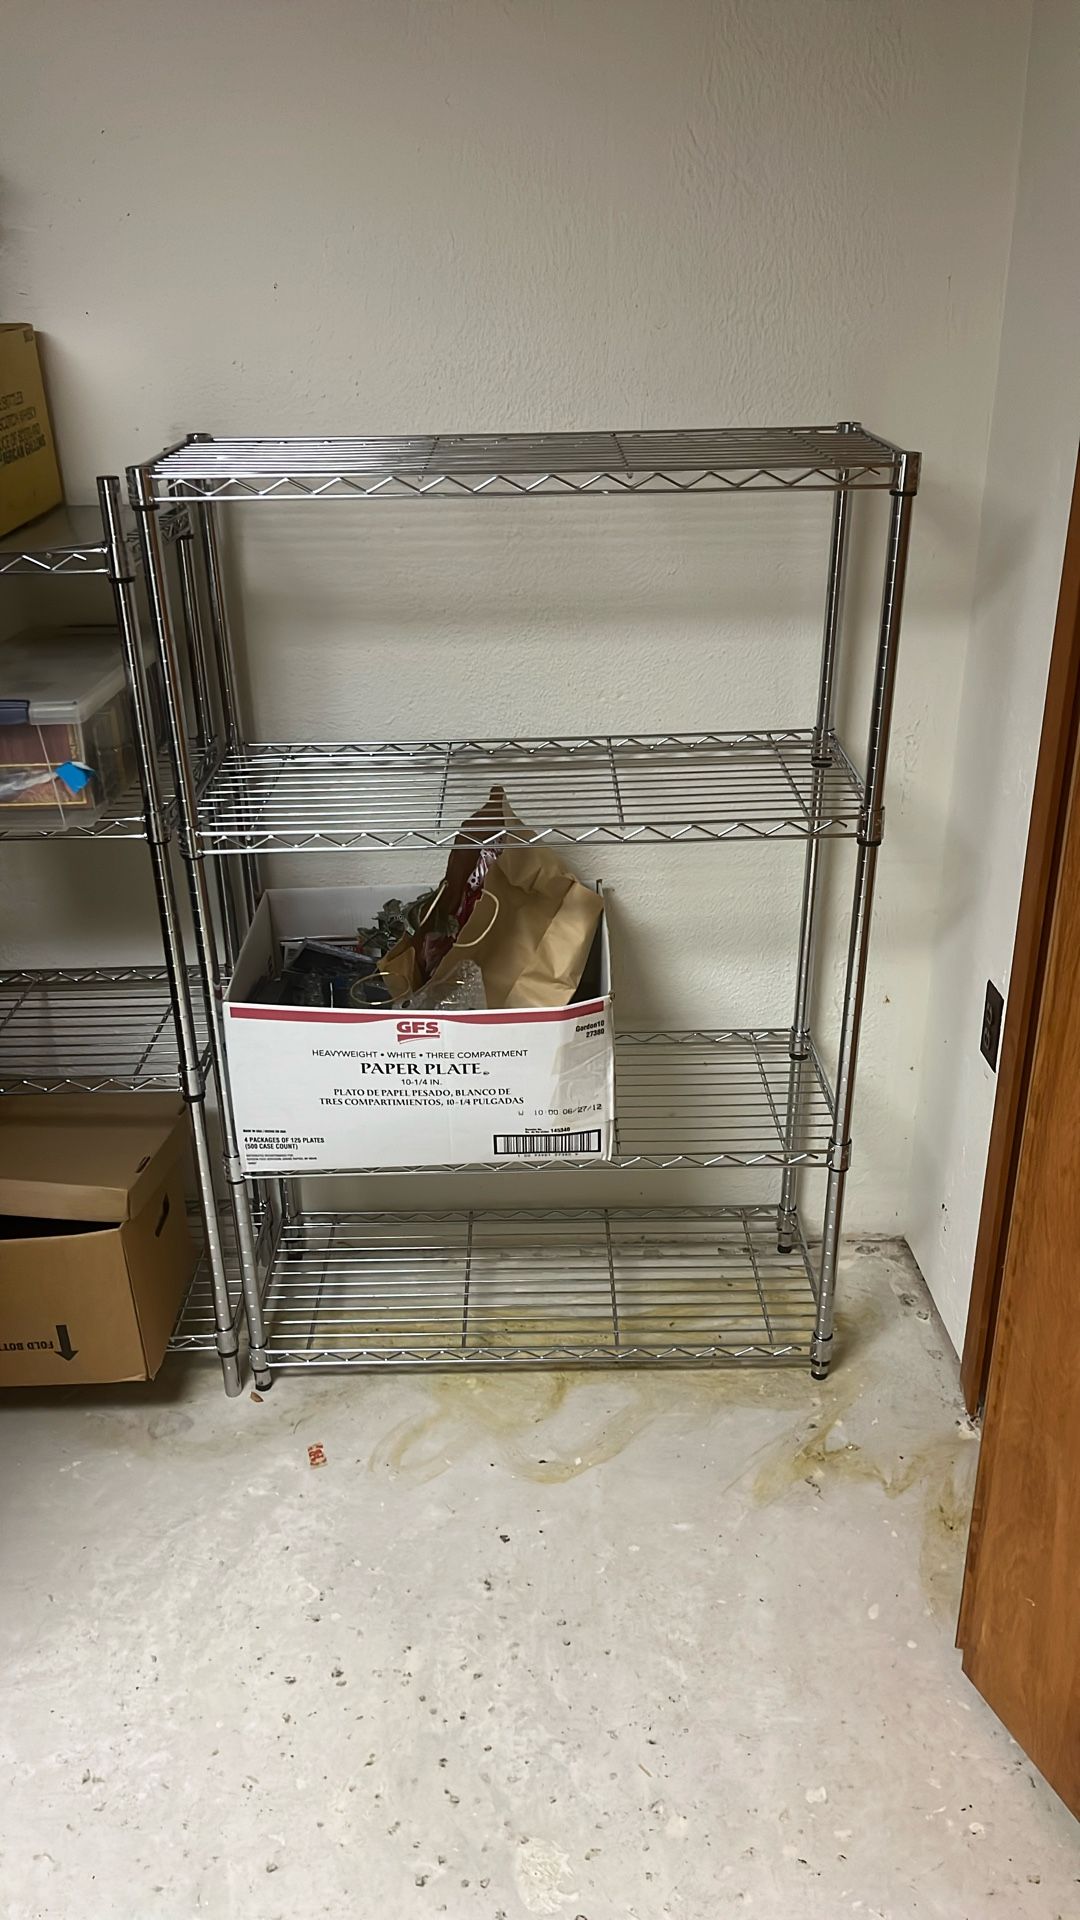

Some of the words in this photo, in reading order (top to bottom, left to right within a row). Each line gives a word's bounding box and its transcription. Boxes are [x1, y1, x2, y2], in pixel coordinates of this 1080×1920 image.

[396, 1021, 440, 1034] GFS
[312, 1049, 378, 1058] HEAVYWEIGHT
[426, 1051, 455, 1059] THREE
[457, 1050, 529, 1059] COMPARTMENT
[360, 1062, 421, 1075] PAPER
[424, 1063, 481, 1075] PLATE
[401, 1078, 428, 1086] 10-1/4
[333, 1088, 365, 1096] PLATO
[381, 1089, 410, 1097] PAPEL
[412, 1089, 454, 1097] PESADO,
[455, 1088, 497, 1096] BLANCO
[498, 1088, 512, 1096] DE
[320, 1097, 343, 1106] TRES
[344, 1098, 444, 1107] COMPARTIMIENTOS,
[446, 1098, 471, 1106] 10-1/4
[473, 1097, 524, 1105] PULGADAS
[0, 1343, 24, 1351] BOT
[27, 1341, 54, 1349] FOLD
